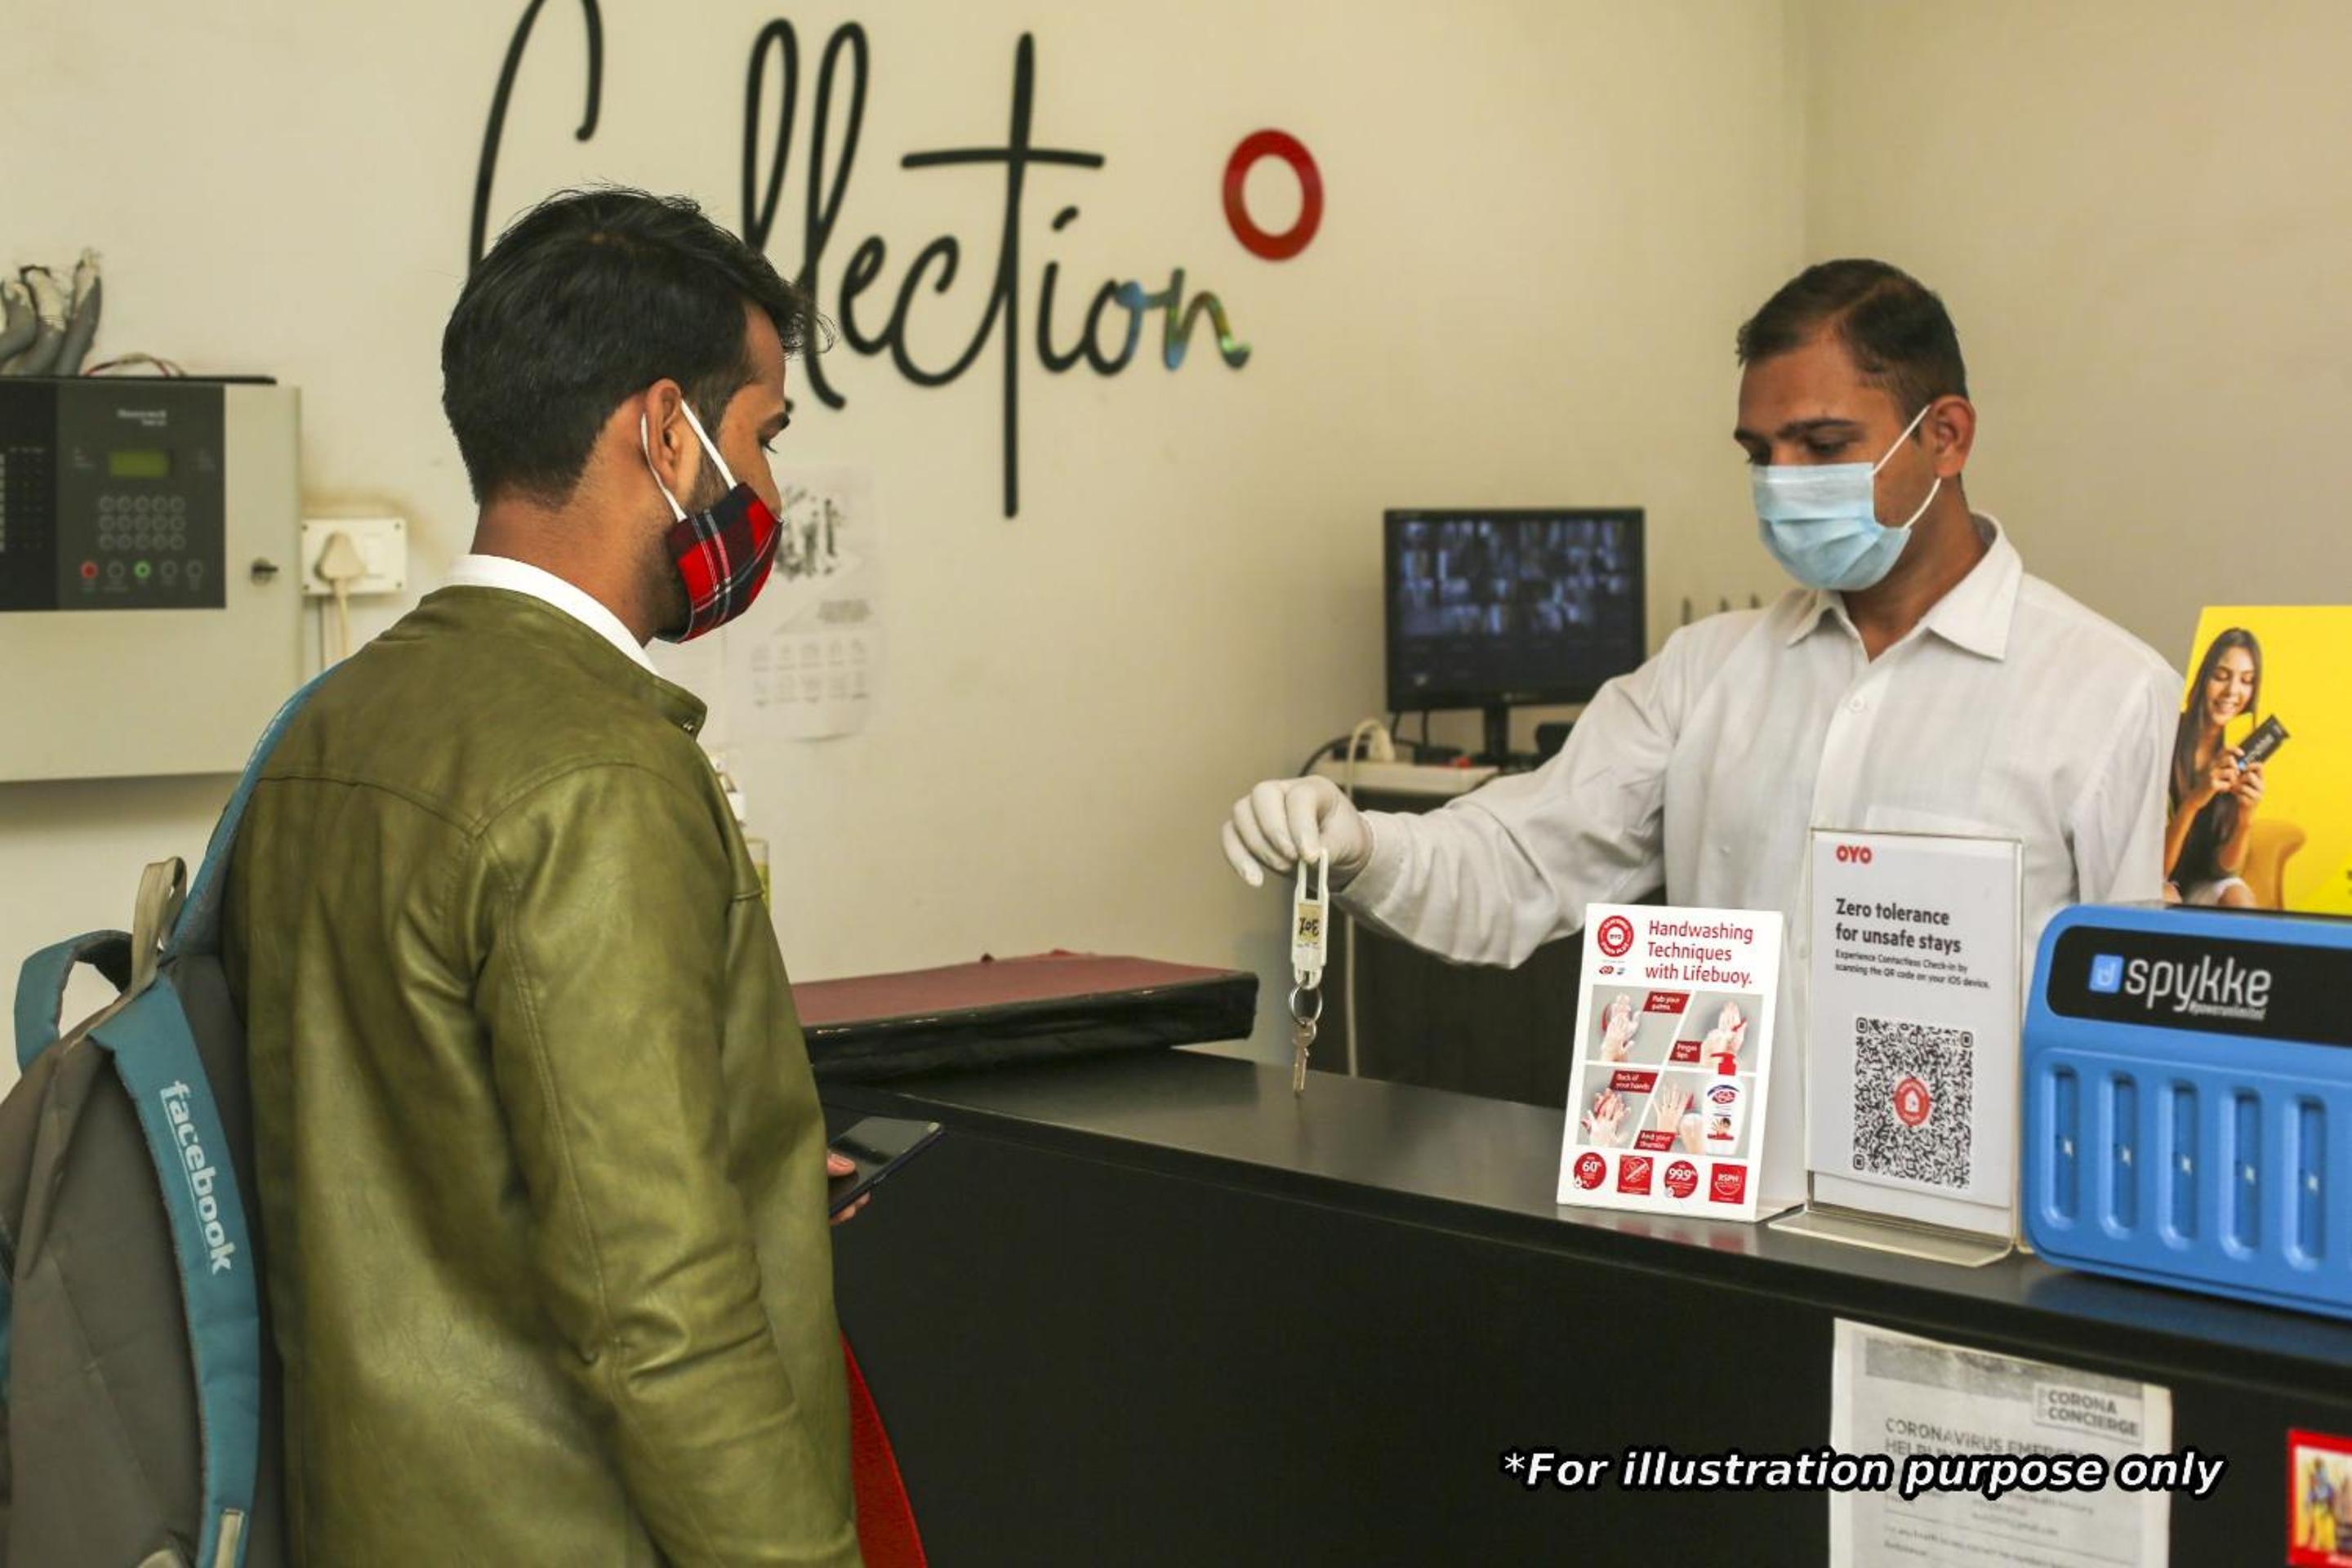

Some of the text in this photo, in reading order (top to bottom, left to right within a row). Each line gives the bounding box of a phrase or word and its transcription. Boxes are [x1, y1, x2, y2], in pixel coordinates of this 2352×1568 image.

[468, 0, 1252, 519] Cllection
[1836, 844, 1872, 864] OYO
[1835, 898, 1950, 926] Zero tolerance
[1648, 920, 1753, 945] Handwashing
[1835, 923, 1962, 956] for unsafe stays
[1647, 941, 1732, 964] Techniques
[1835, 948, 1876, 962] Experience
[1958, 962, 1967, 975] by
[1645, 963, 1753, 988] with Lifebuoy.
[1835, 964, 1868, 977] scanning
[1869, 965, 1882, 976] the
[1884, 968, 1895, 978] QR
[1896, 970, 1915, 979] code
[2125, 955, 2272, 1013] spykke
[160, 1080, 237, 1276] facebook
[2047, 1389, 2118, 1414] CORONA
[2047, 1406, 2139, 1437] CONCIERGE
[1885, 1417, 2004, 1454] CORONAVIRUS
